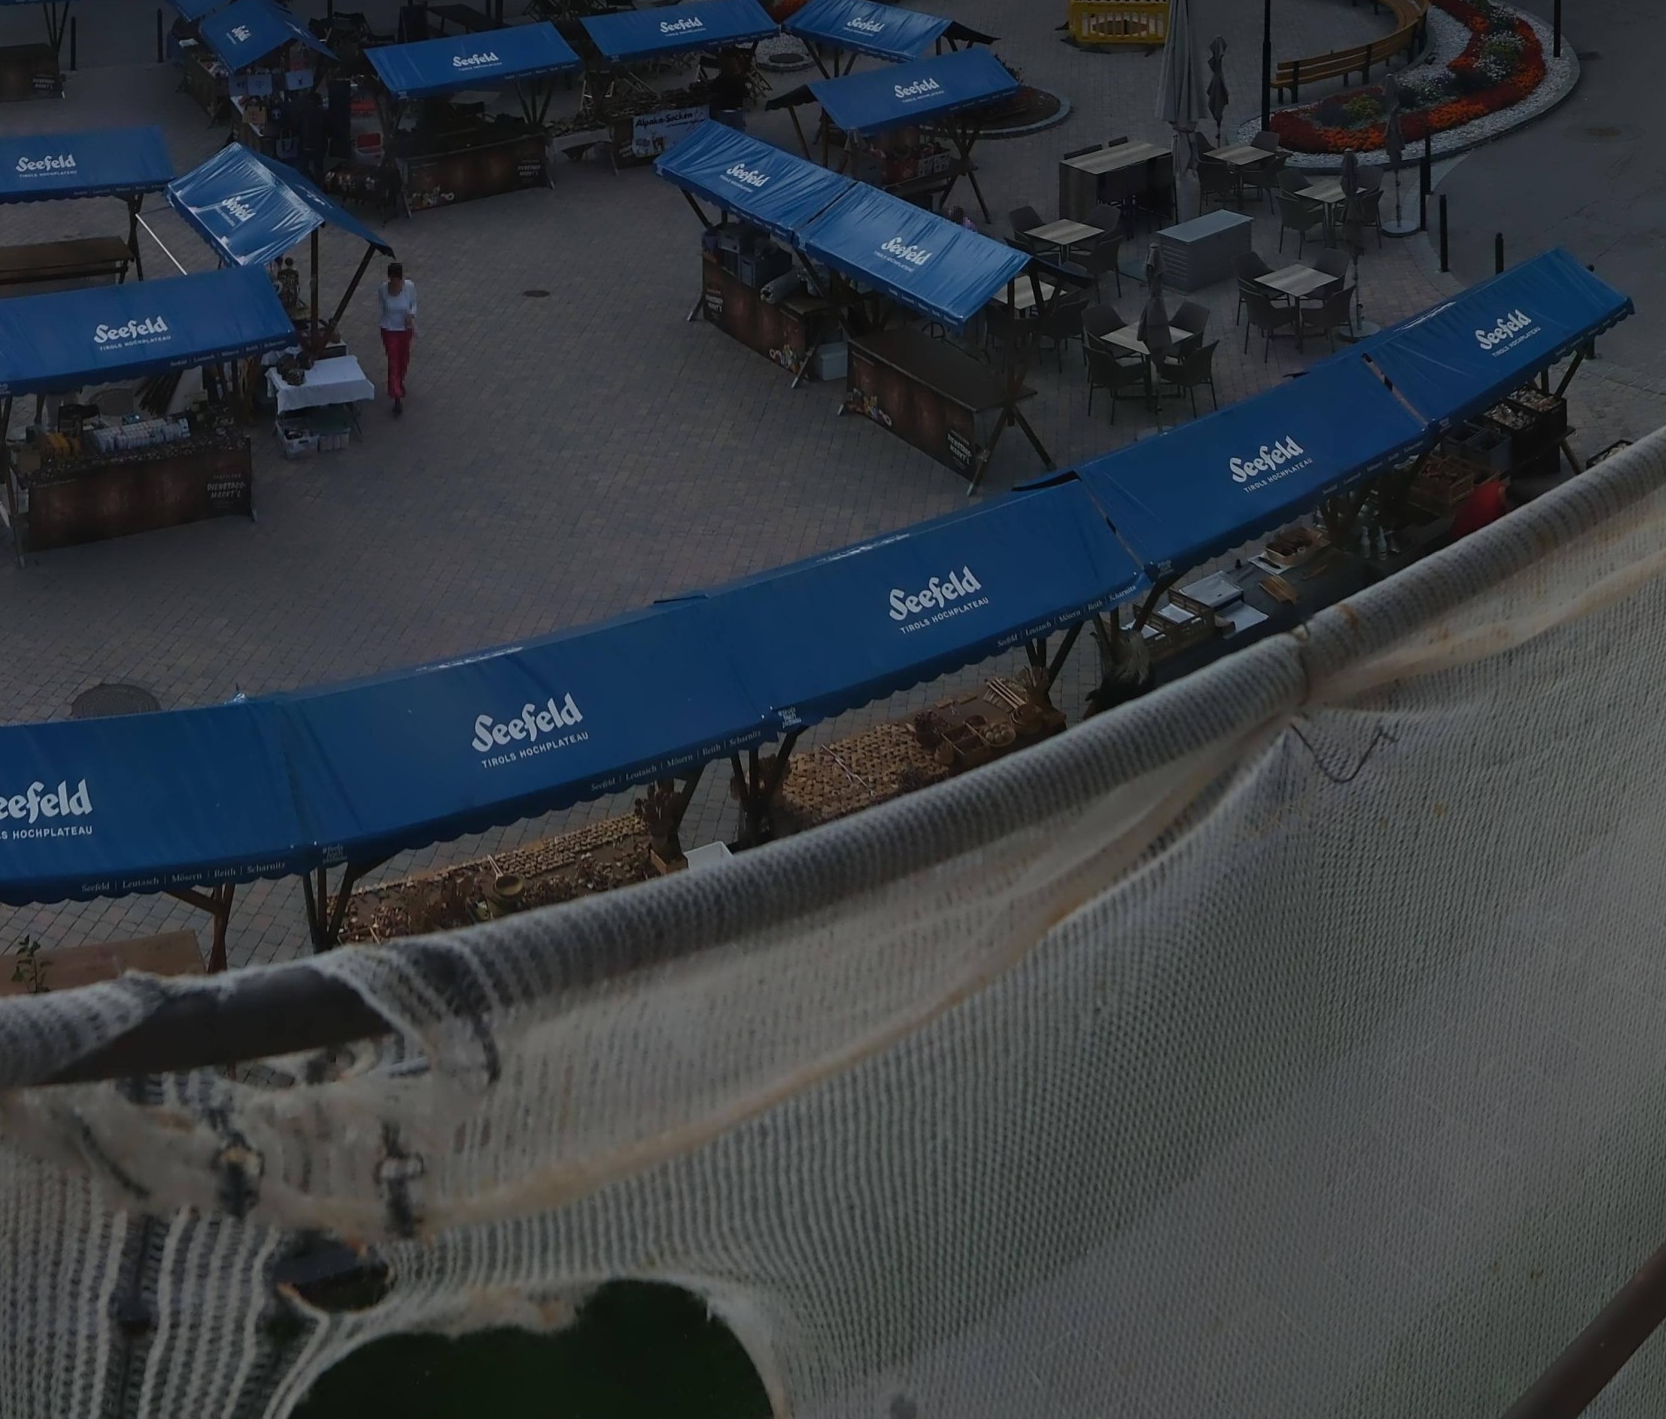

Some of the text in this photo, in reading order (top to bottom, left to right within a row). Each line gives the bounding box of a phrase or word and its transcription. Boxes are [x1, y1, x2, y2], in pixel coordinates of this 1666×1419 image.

[660, 16, 703, 34] Seefeld
[452, 52, 499, 68] Seefeld
[893, 77, 940, 99] Seefeld
[15, 154, 76, 172] Seefeld
[726, 163, 771, 188] Seefeld
[880, 236, 933, 266] Seefeld
[93, 316, 169, 347] Seefeld
[1475, 309, 1532, 350] Seefeld
[1229, 435, 1304, 483] Seefeld
[889, 565, 982, 621] Seefeld
[899, 596, 990, 635] TIROLS HOCHPLATEAU
[472, 692, 583, 752] Seefeld
[482, 731, 589, 769] TIROLS HOCHPLATEAU
[13, 826, 93, 840] HOCHPLATEAU
[82, 861, 286, 893] Seefeld Leutasch Mösern Reith Scharnitz
